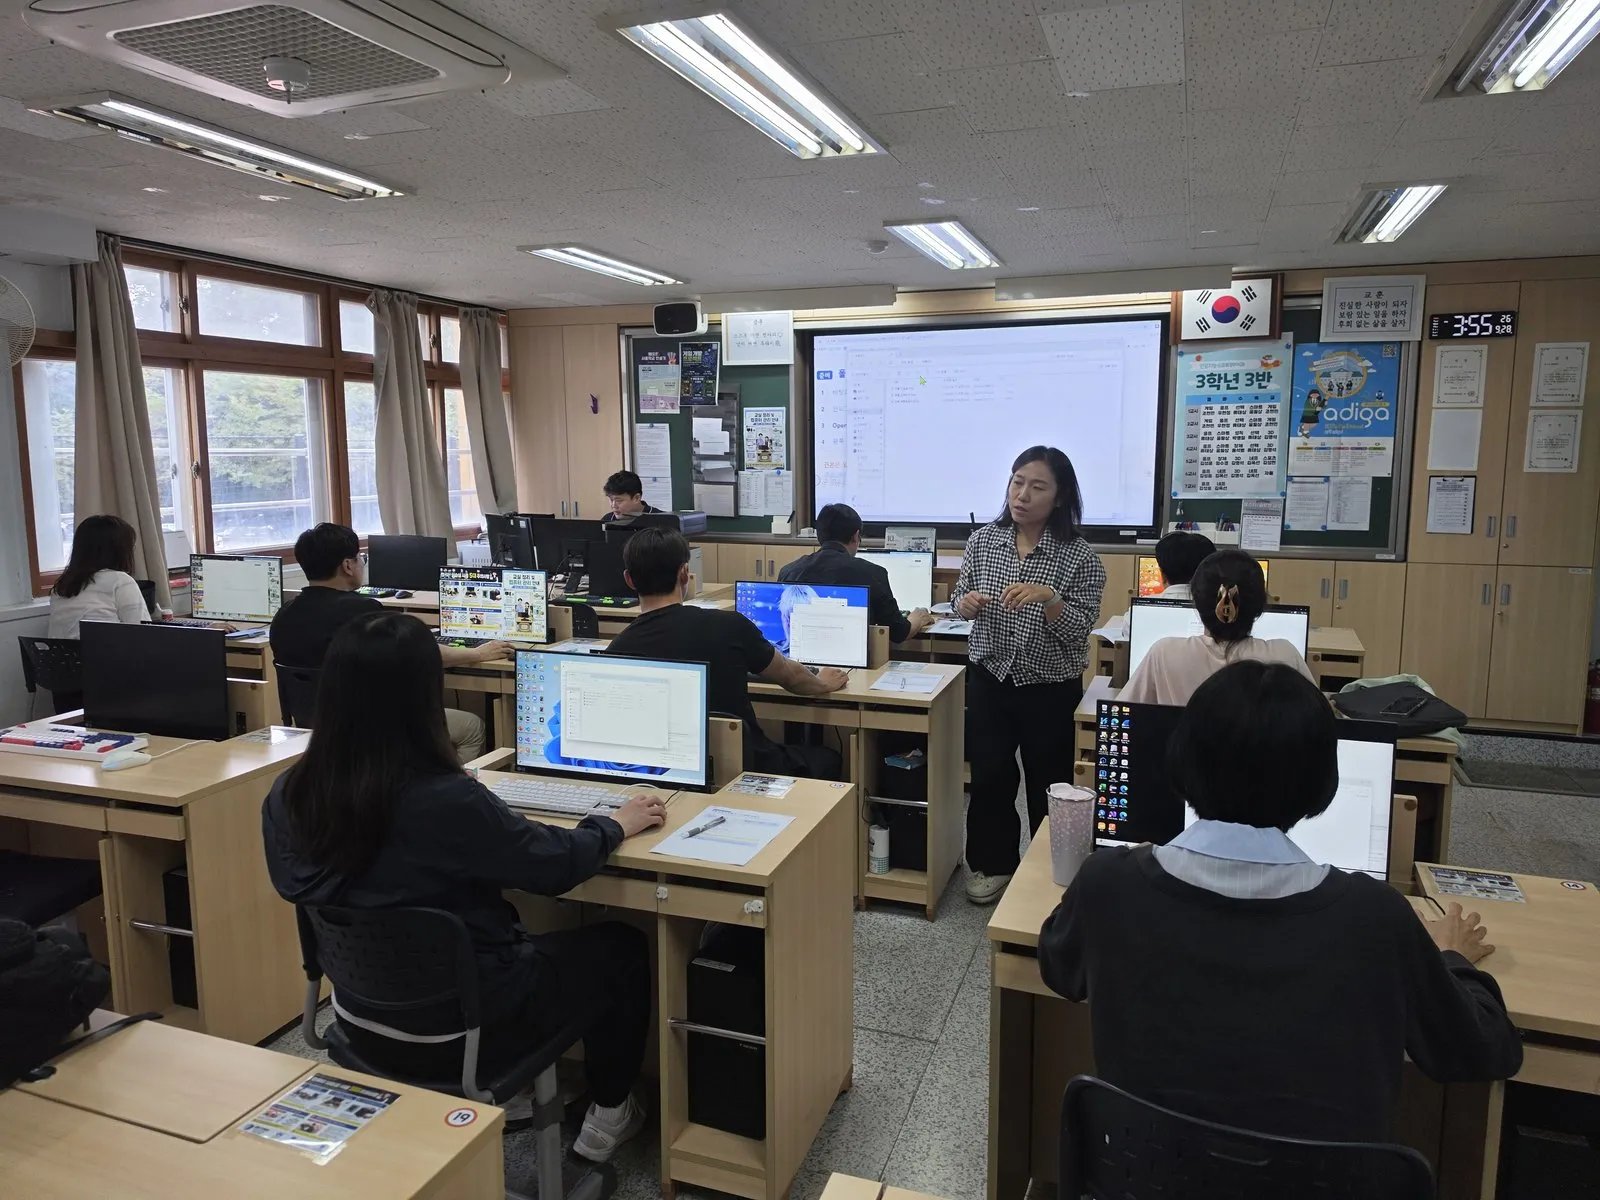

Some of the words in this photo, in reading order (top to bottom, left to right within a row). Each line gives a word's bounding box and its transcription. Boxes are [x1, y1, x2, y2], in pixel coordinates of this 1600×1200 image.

[1339, 301, 1362, 310] 진실한
[1365, 301, 1388, 309] 사람이
[1393, 300, 1408, 308] 되자
[1338, 311, 1353, 319] 보람
[1356, 310, 1370, 319] 있는
[1374, 310, 1388, 318] 일을
[1391, 310, 1406, 318] 하자
[1356, 320, 1370, 328] 없는
[1372, 320, 1388, 328] 삶을
[1391, 319, 1406, 327] 살자
[1452, 314, 1493, 336] 3:55
[1196, 373, 1239, 391] 3학년
[1245, 371, 1273, 389] 3반
[1323, 402, 1389, 428] adiga
[453, 1112, 470, 1122] 19
